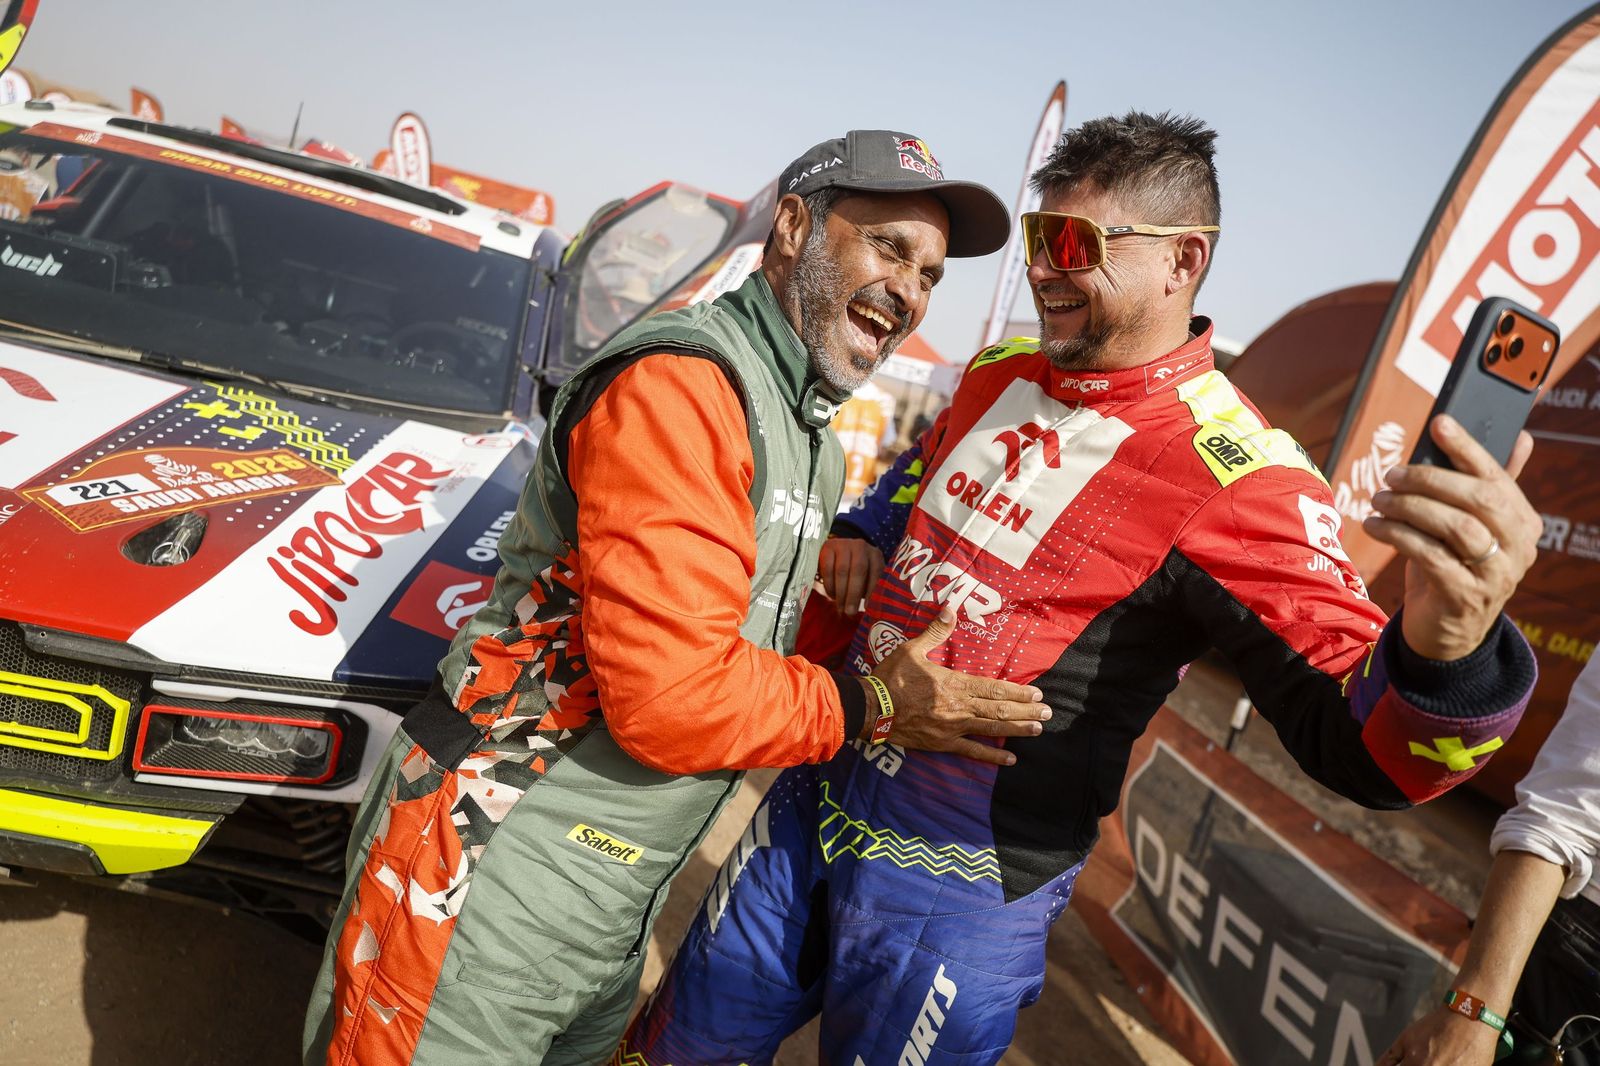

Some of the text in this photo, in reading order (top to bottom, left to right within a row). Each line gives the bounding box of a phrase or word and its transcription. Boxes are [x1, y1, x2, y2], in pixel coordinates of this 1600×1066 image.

[788, 157, 844, 190] DACIA
[211, 453, 307, 479] 2026
[1205, 435, 1250, 468] OMP
[69, 479, 139, 501] 221
[110, 473, 298, 513] SAUDI ARABIA
[576, 829, 637, 862] Sabelt
[897, 963, 958, 1066] ORTS
